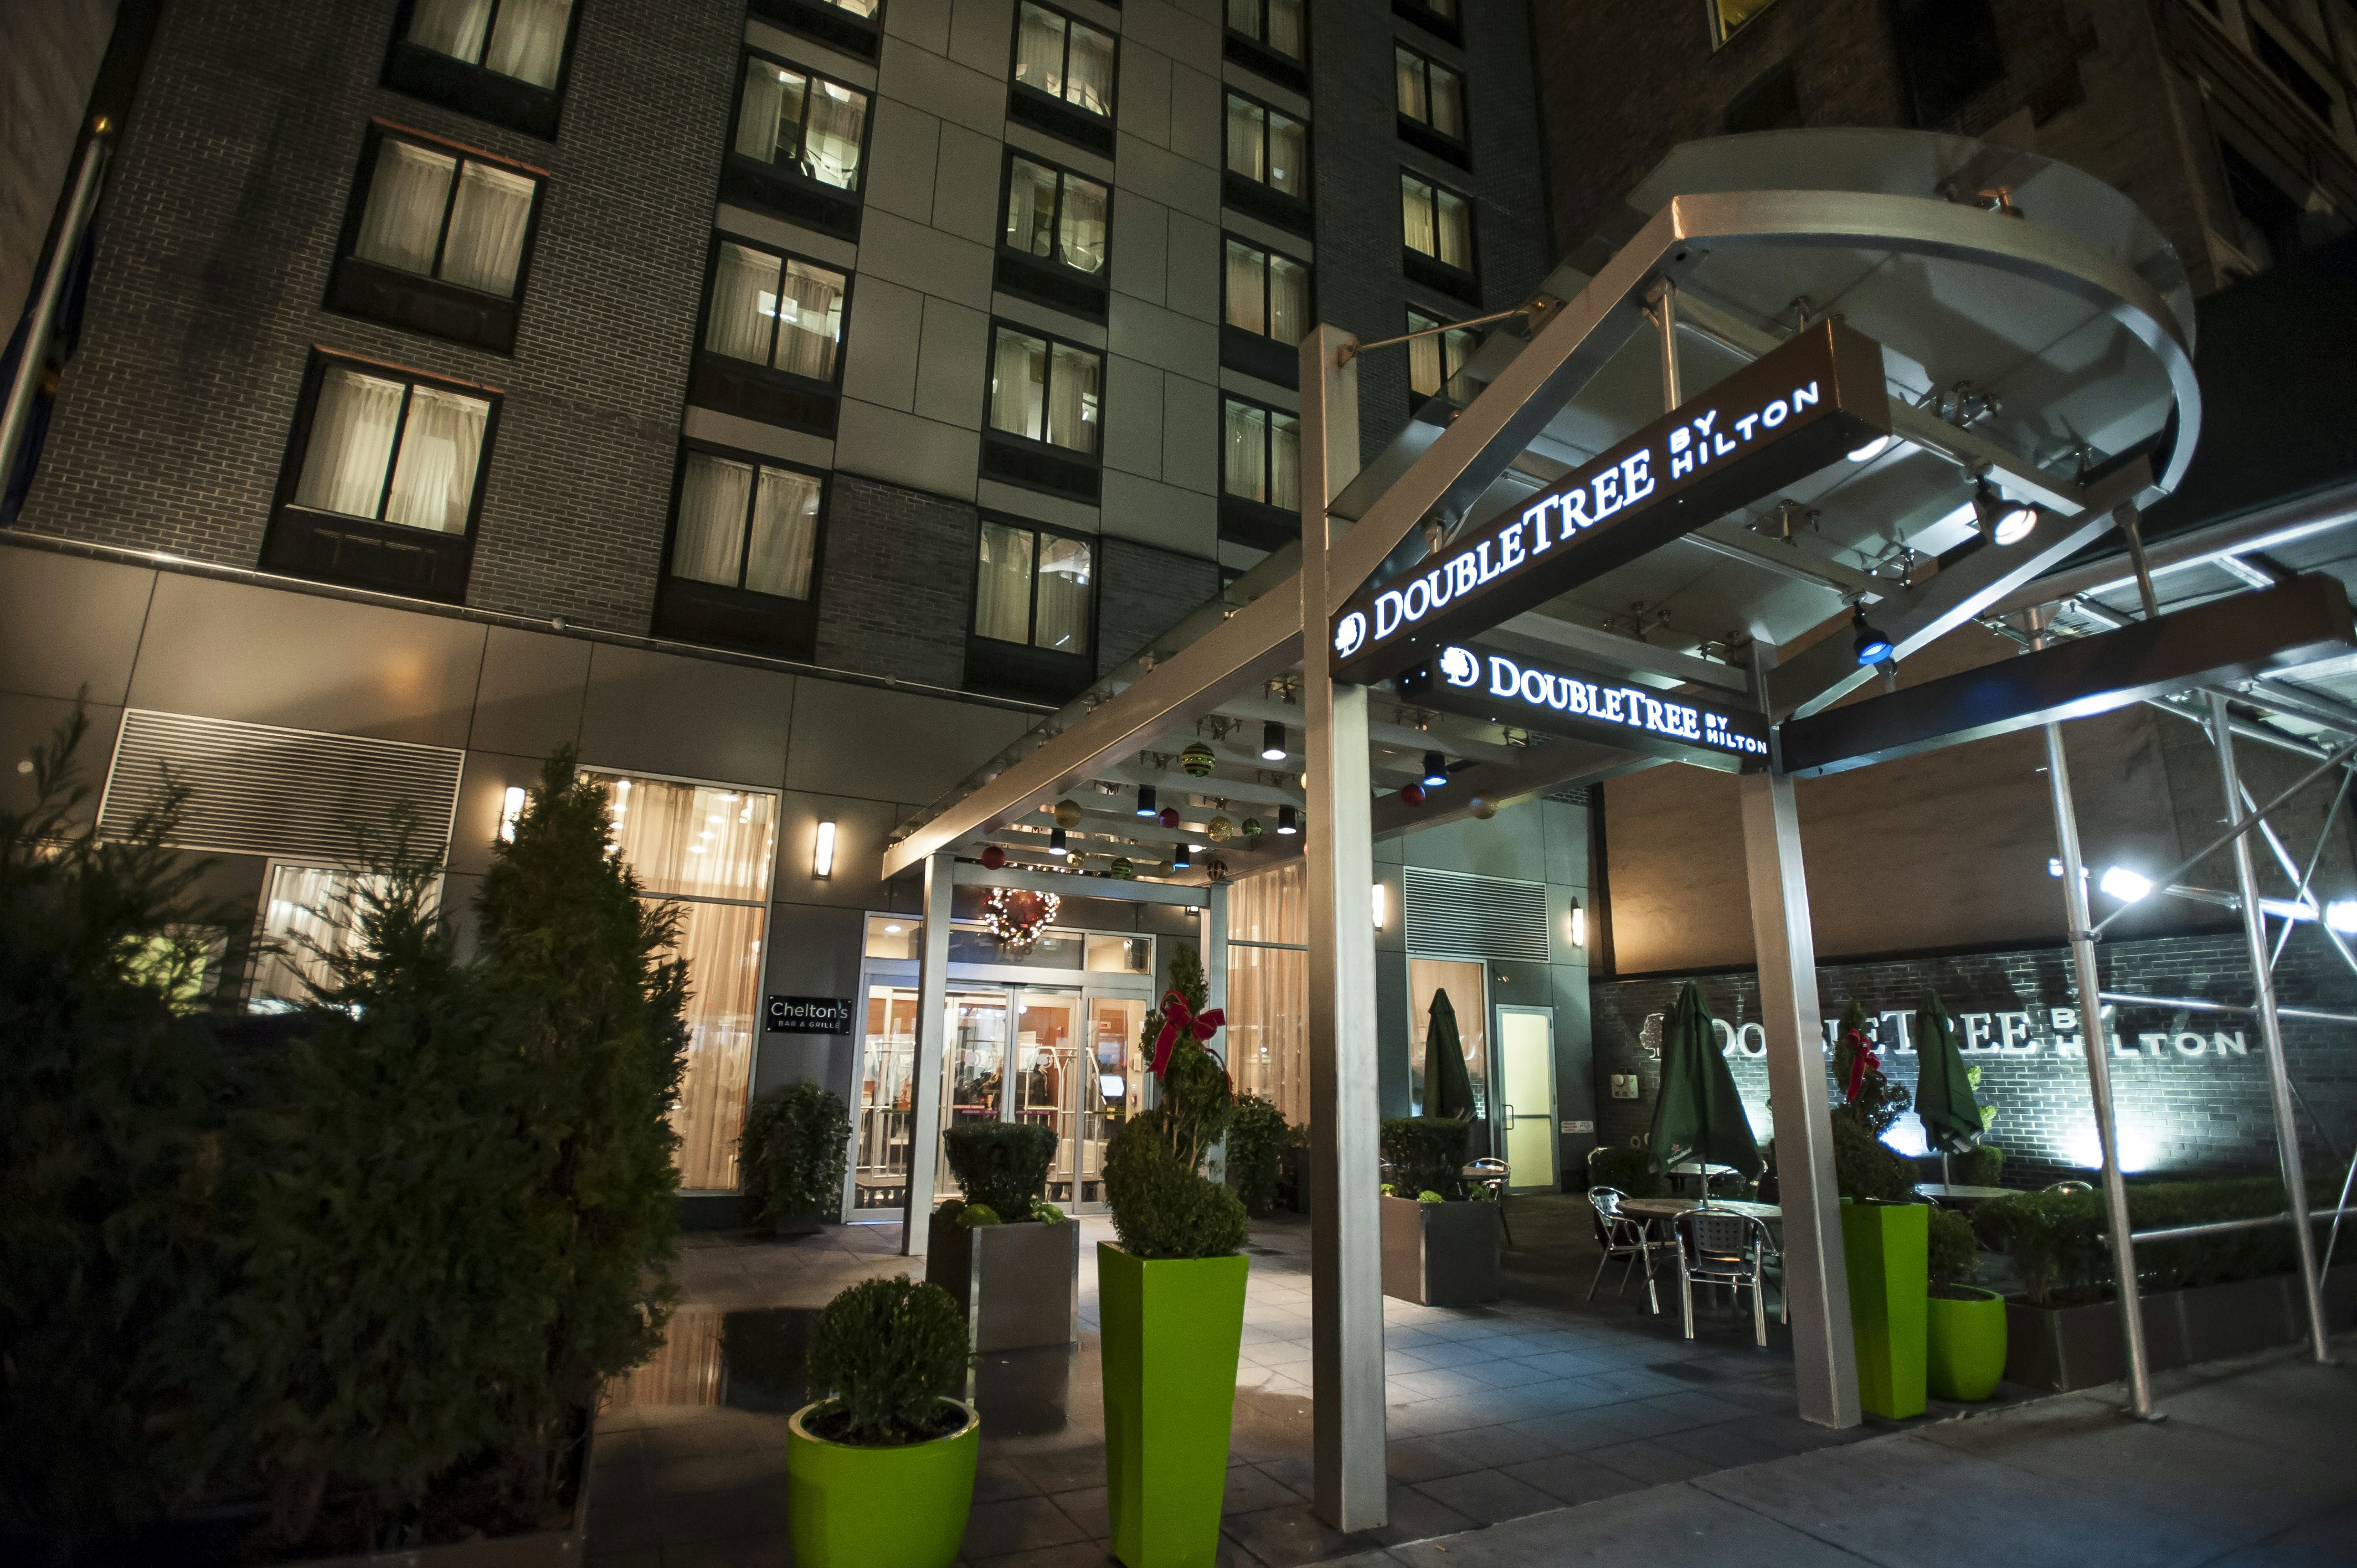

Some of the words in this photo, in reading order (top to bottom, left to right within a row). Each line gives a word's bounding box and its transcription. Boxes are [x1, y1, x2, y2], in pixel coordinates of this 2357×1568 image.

[1669, 409, 1716, 455] BY
[1671, 380, 1819, 480] HILTON
[1705, 713, 1728, 730] BY
[1706, 729, 1768, 754] HILTON
[771, 1002, 848, 1019] Chelton's
[2056, 1031, 2247, 1056] HLTON
